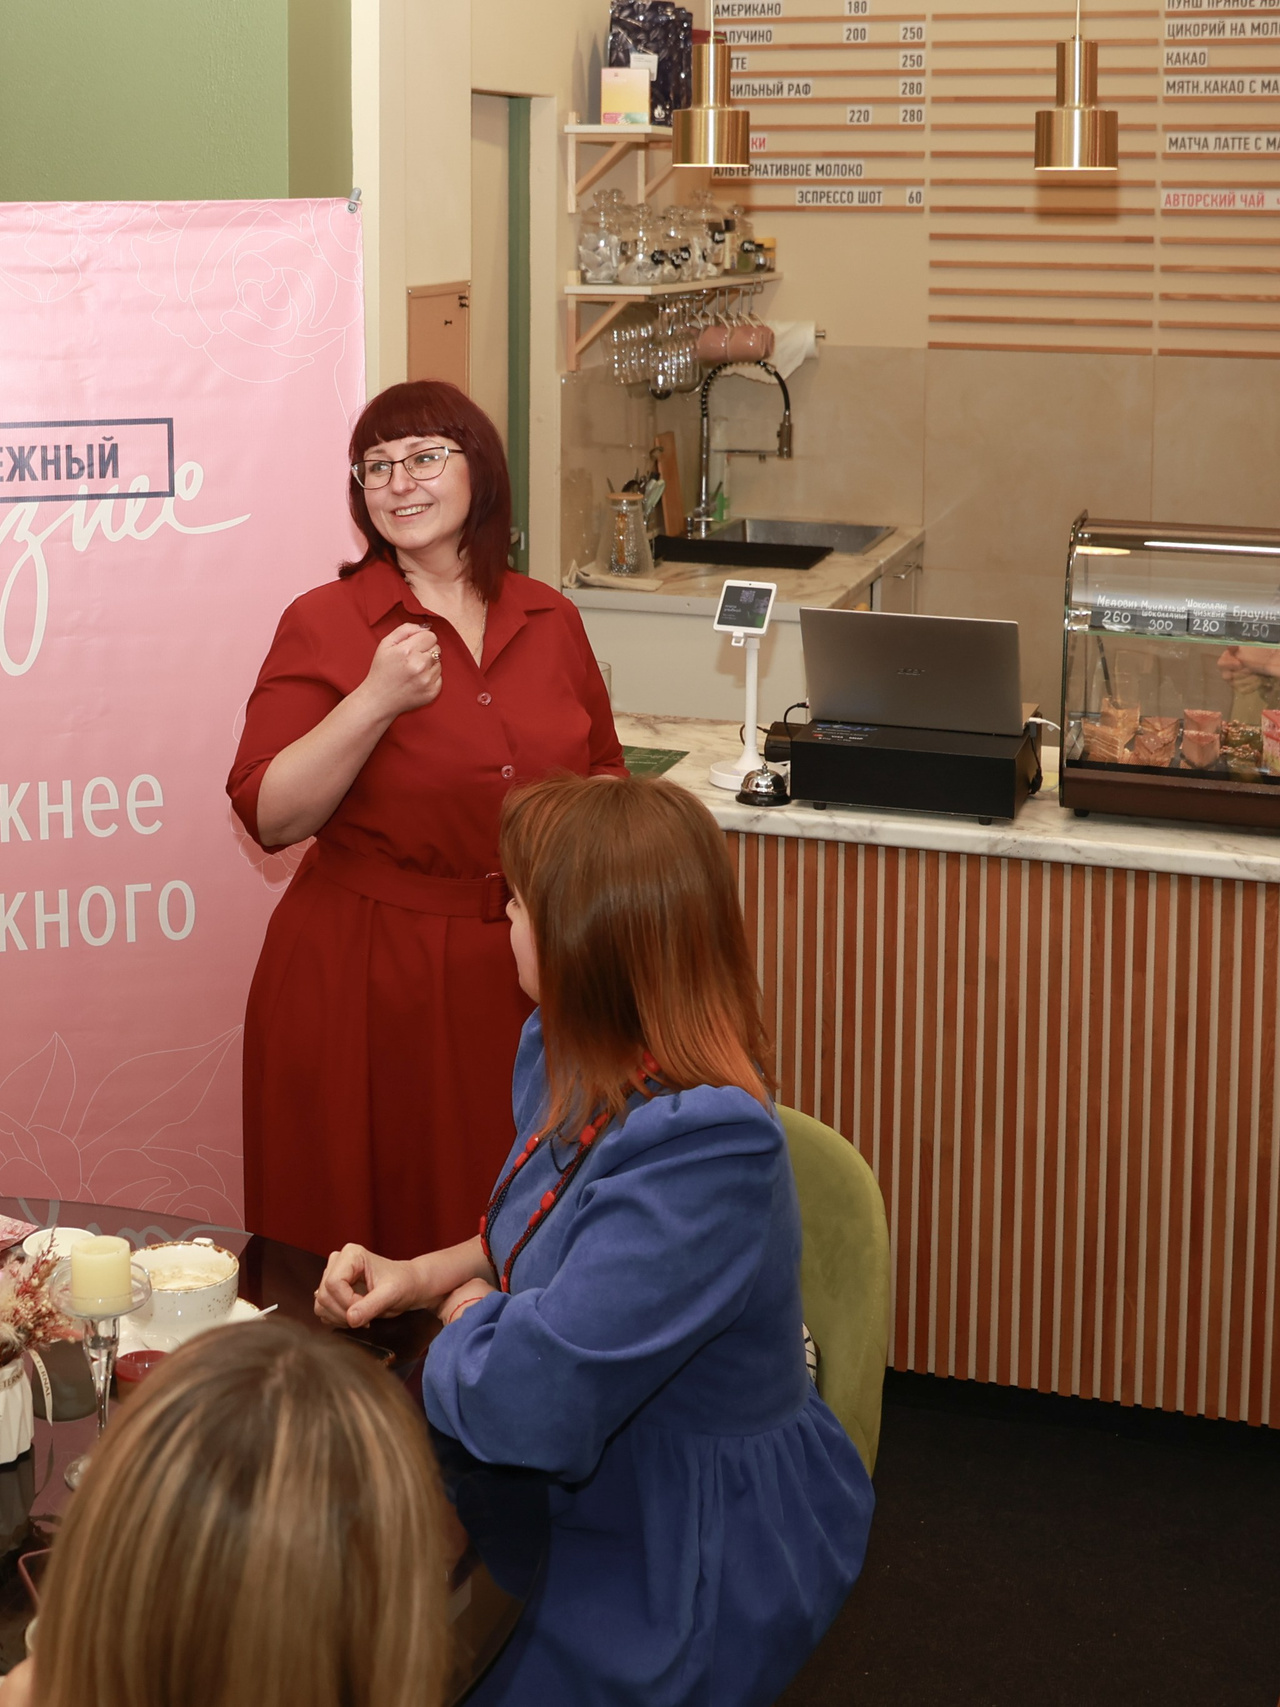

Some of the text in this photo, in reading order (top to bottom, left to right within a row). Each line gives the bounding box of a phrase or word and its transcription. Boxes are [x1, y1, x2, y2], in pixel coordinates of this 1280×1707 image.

[713, 0, 867, 17] АМЕРИКАНО 180
[845, 27, 867, 42] 200
[901, 26, 923, 41] 250
[1167, 20, 1226, 40] ЦИКОРИЙ
[1230, 22, 1246, 37] НА
[901, 54, 923, 69] 250
[1165, 51, 1207, 66] КАКАО
[787, 82, 812, 97] РАФ
[901, 81, 923, 96] 280
[1165, 79, 1245, 95] МЯТН.КАКАО
[1248, 80, 1257, 94] С
[848, 108, 923, 124] 220 280
[1167, 136, 1210, 151] МАТЧА
[1213, 136, 1251, 151] ЛАТТЕ
[1254, 136, 1262, 151] С
[713, 163, 863, 178] АЛЬТЕРНАТИВНОЕ МОЛОКО
[797, 190, 922, 205] ЭСПРЕССО ШОТ 60
[1163, 190, 1265, 208] АВТОРСКИЙ ЧАЙ
[1101, 610, 1131, 624] 260
[1148, 619, 1173, 631] 300
[1192, 619, 1220, 633] 280
[1241, 622, 1270, 638] 250
